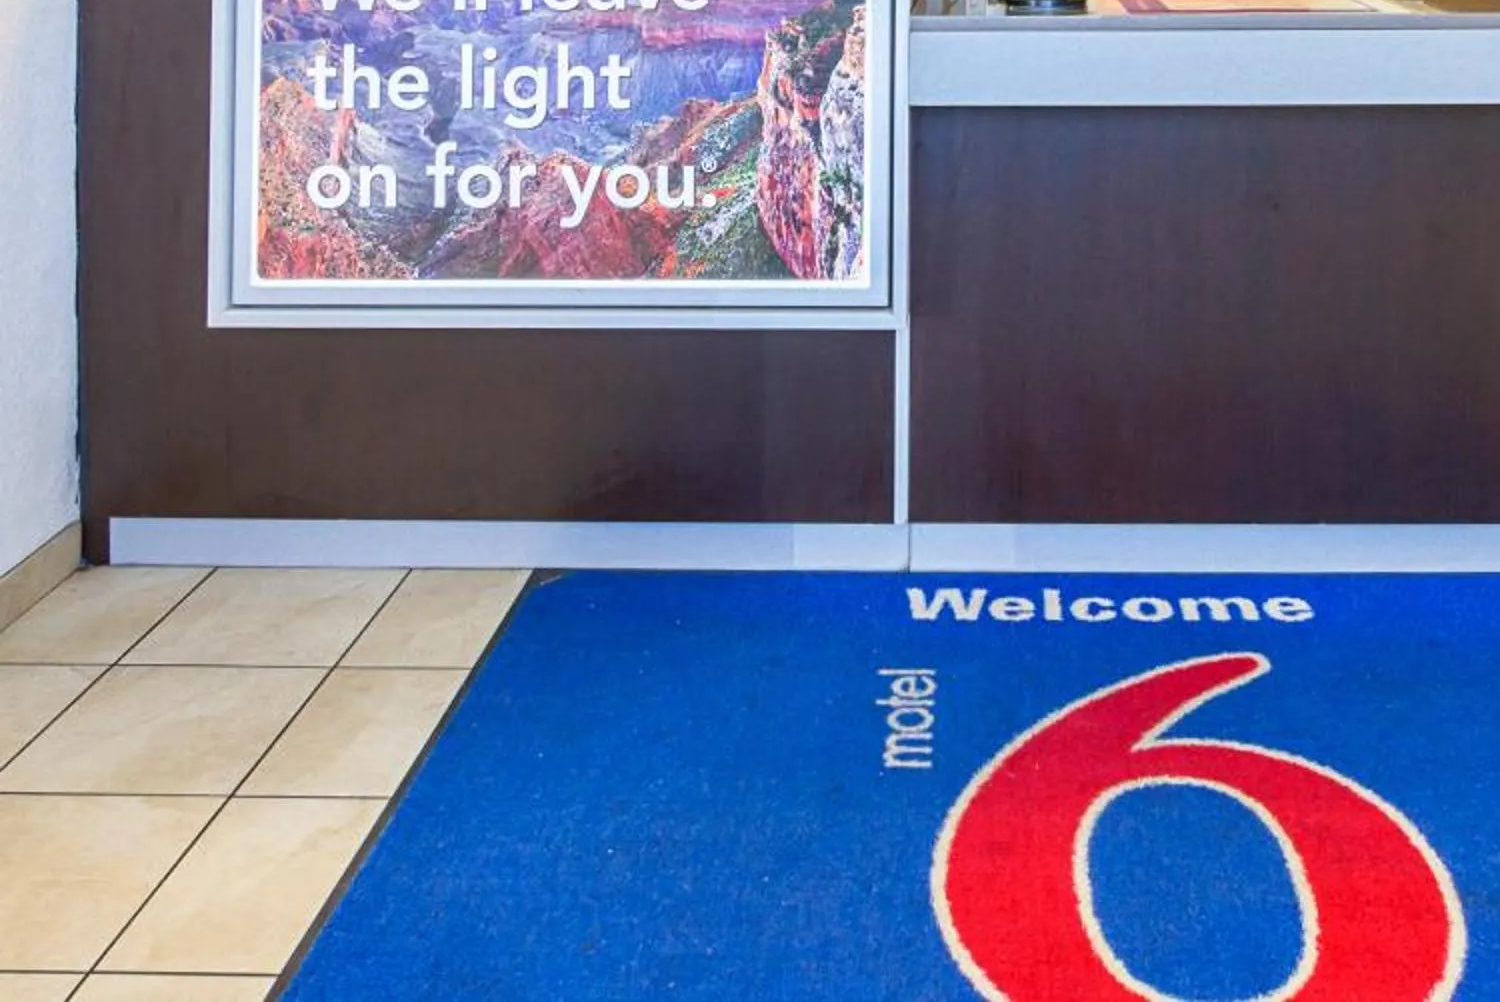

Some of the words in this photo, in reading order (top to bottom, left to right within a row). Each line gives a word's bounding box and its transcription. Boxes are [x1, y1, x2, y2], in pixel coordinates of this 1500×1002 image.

[307, 43, 430, 112] the
[461, 43, 633, 130] light
[307, 164, 398, 210] on
[426, 141, 538, 210] for
[905, 586, 1316, 623] Welcome
[876, 668, 937, 770] motel
[929, 650, 1468, 1002] 6
